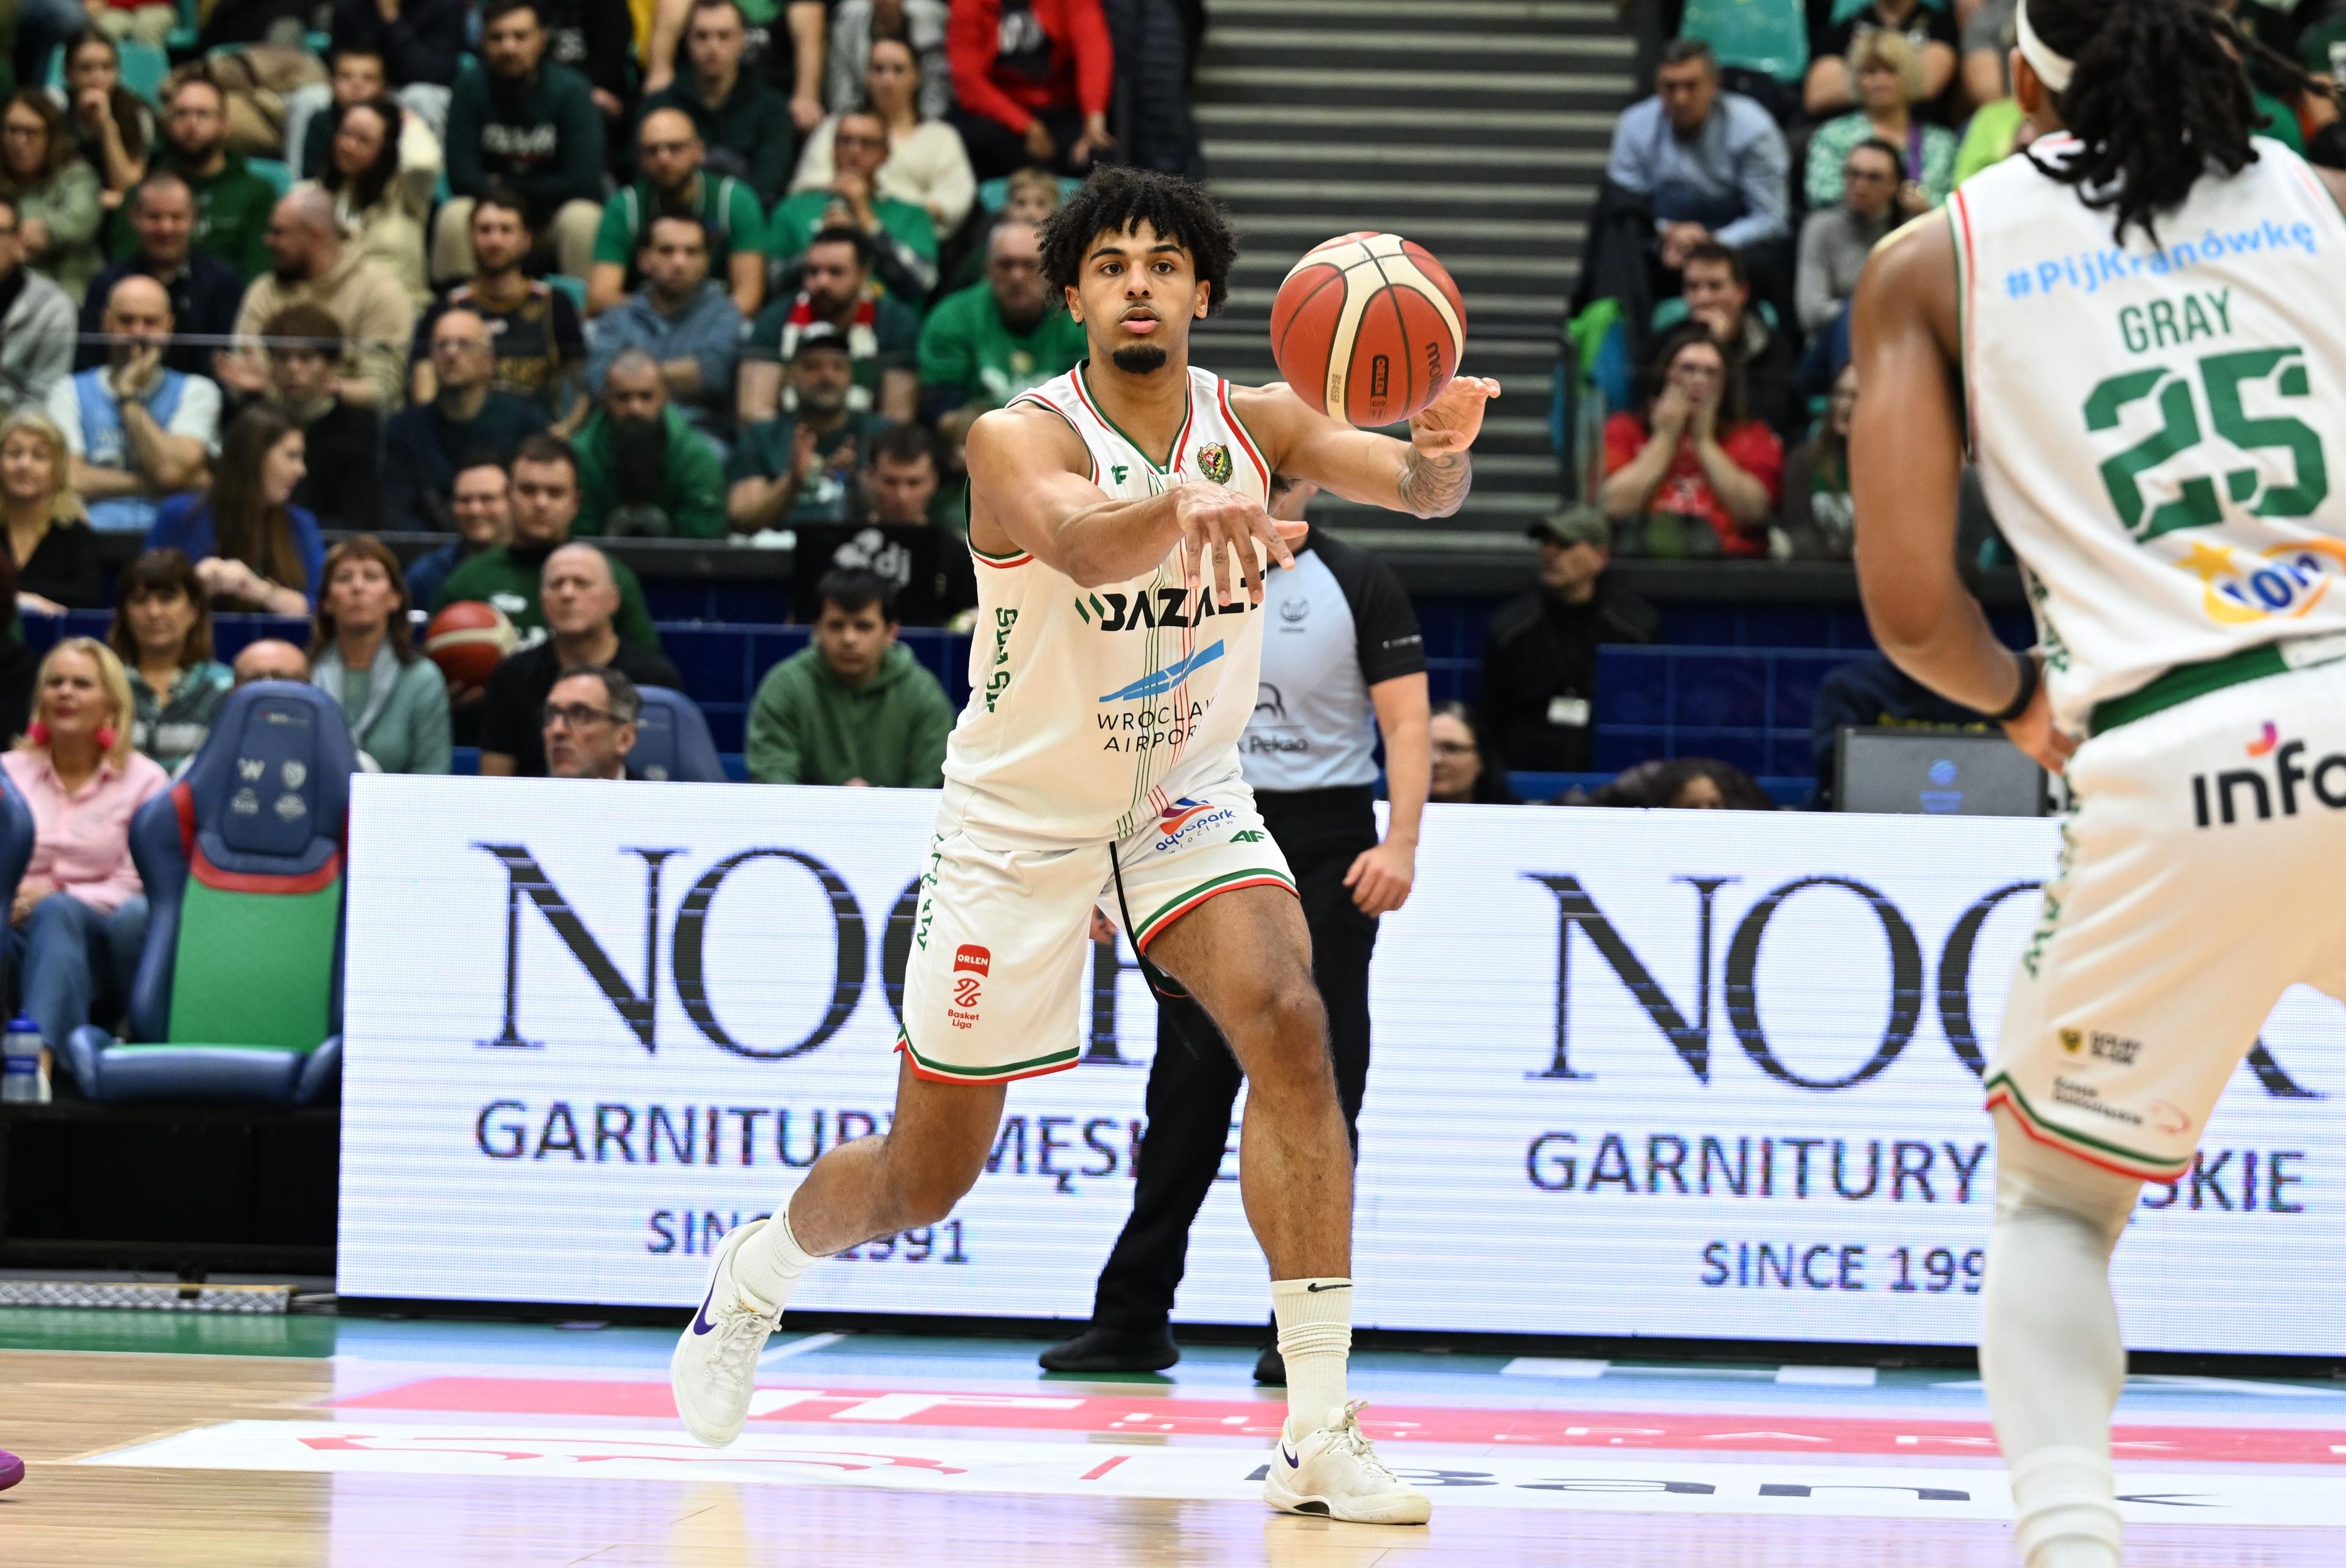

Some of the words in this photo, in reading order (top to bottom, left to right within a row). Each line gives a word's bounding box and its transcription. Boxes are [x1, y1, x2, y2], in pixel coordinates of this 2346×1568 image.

[2003, 218, 2318, 299] #PijKranówkę
[2118, 290, 2235, 354] GRAY
[2082, 346, 2330, 544] 25
[1103, 718, 1203, 753] AIRPOR
[2192, 740, 2346, 827] info
[470, 843, 1154, 1064] NO
[957, 954, 988, 966] ORLEN
[948, 1008, 980, 1021] Basket
[952, 1018, 973, 1030] Liga
[477, 1099, 893, 1168] GARNITUR
[1526, 1132, 1988, 1203] GARNITURY
[1700, 1241, 1868, 1291] SINCE
[1891, 1247, 1983, 1294] 199
